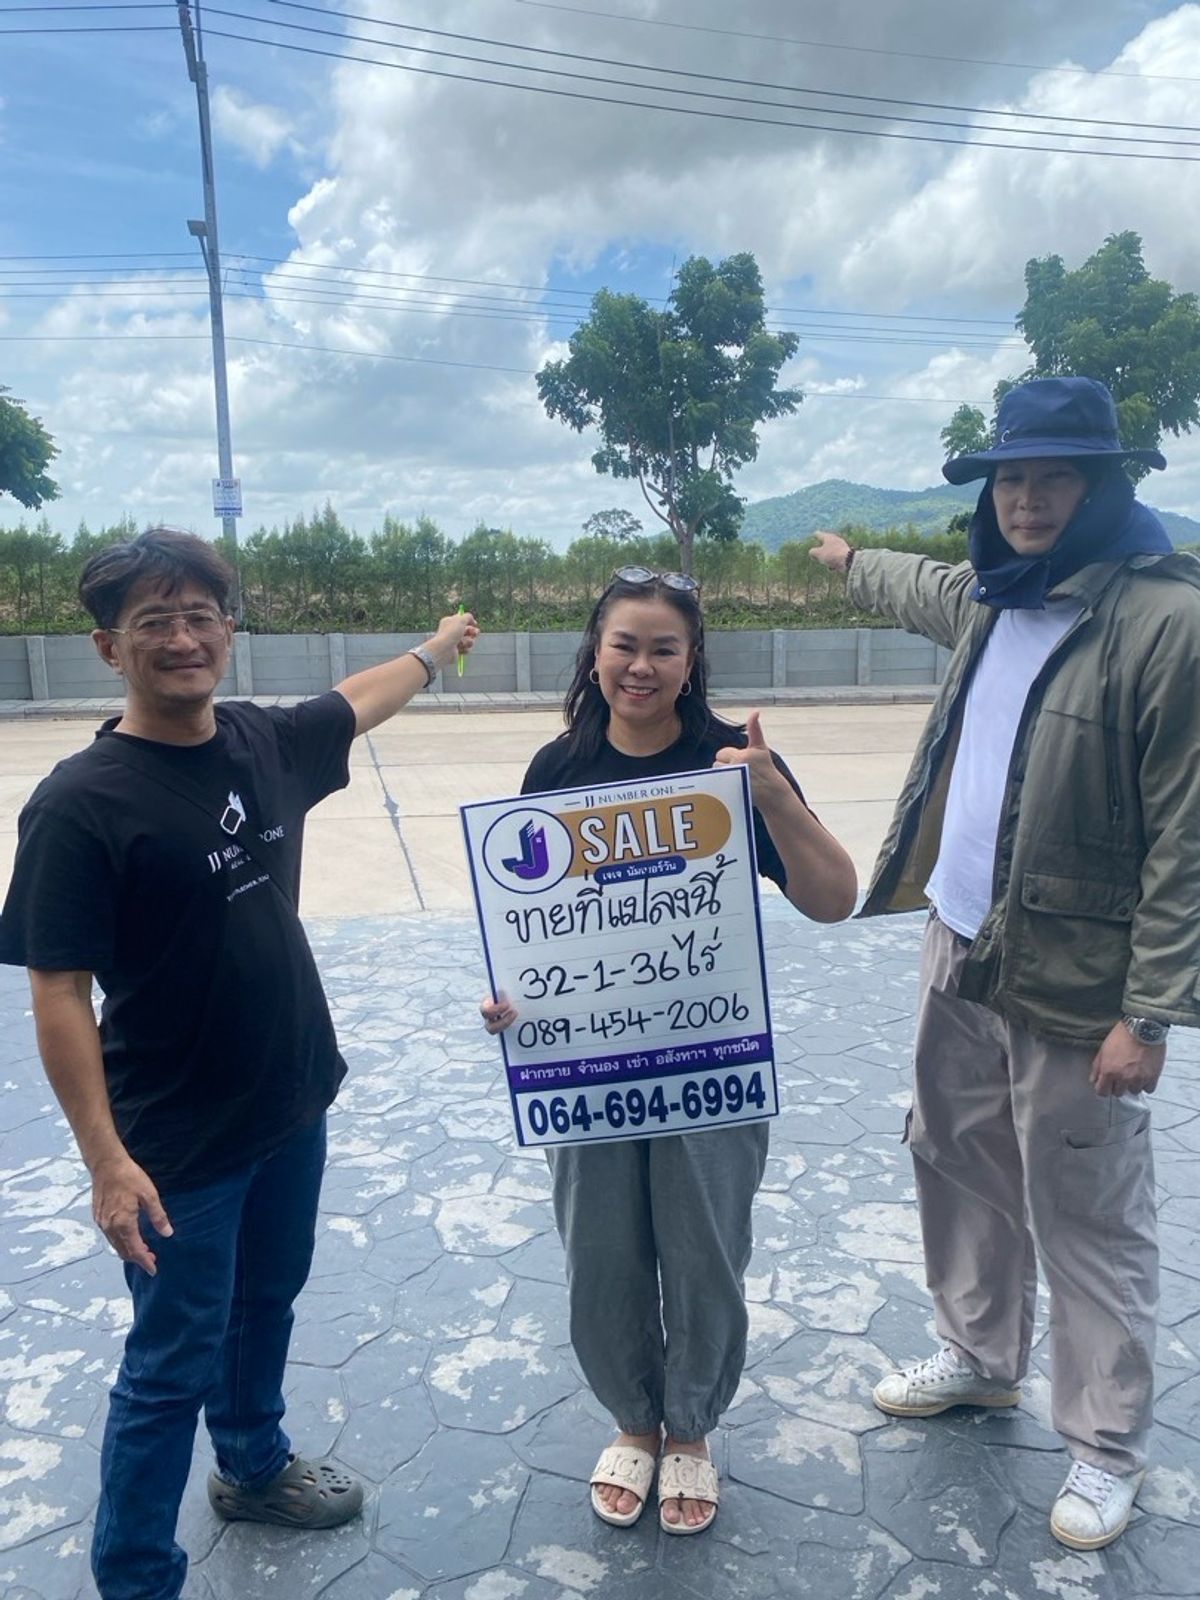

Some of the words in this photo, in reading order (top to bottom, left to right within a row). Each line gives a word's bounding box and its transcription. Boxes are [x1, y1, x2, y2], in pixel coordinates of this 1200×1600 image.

[598, 787, 649, 805] NUMBER
[650, 785, 676, 797] ONE
[578, 803, 698, 866] SALE
[505, 853, 738, 943] ขายที่แปลงนี้
[517, 992, 750, 1049] 089-454-2006
[520, 1065, 571, 1081] ฝากขาย
[577, 1060, 620, 1075] จำนอง
[626, 1054, 649, 1069] เช่า
[656, 1048, 707, 1066] อสังหาฯ
[712, 1038, 760, 1061] ทุกชนิด
[527, 1071, 767, 1137] 064-694-6994
